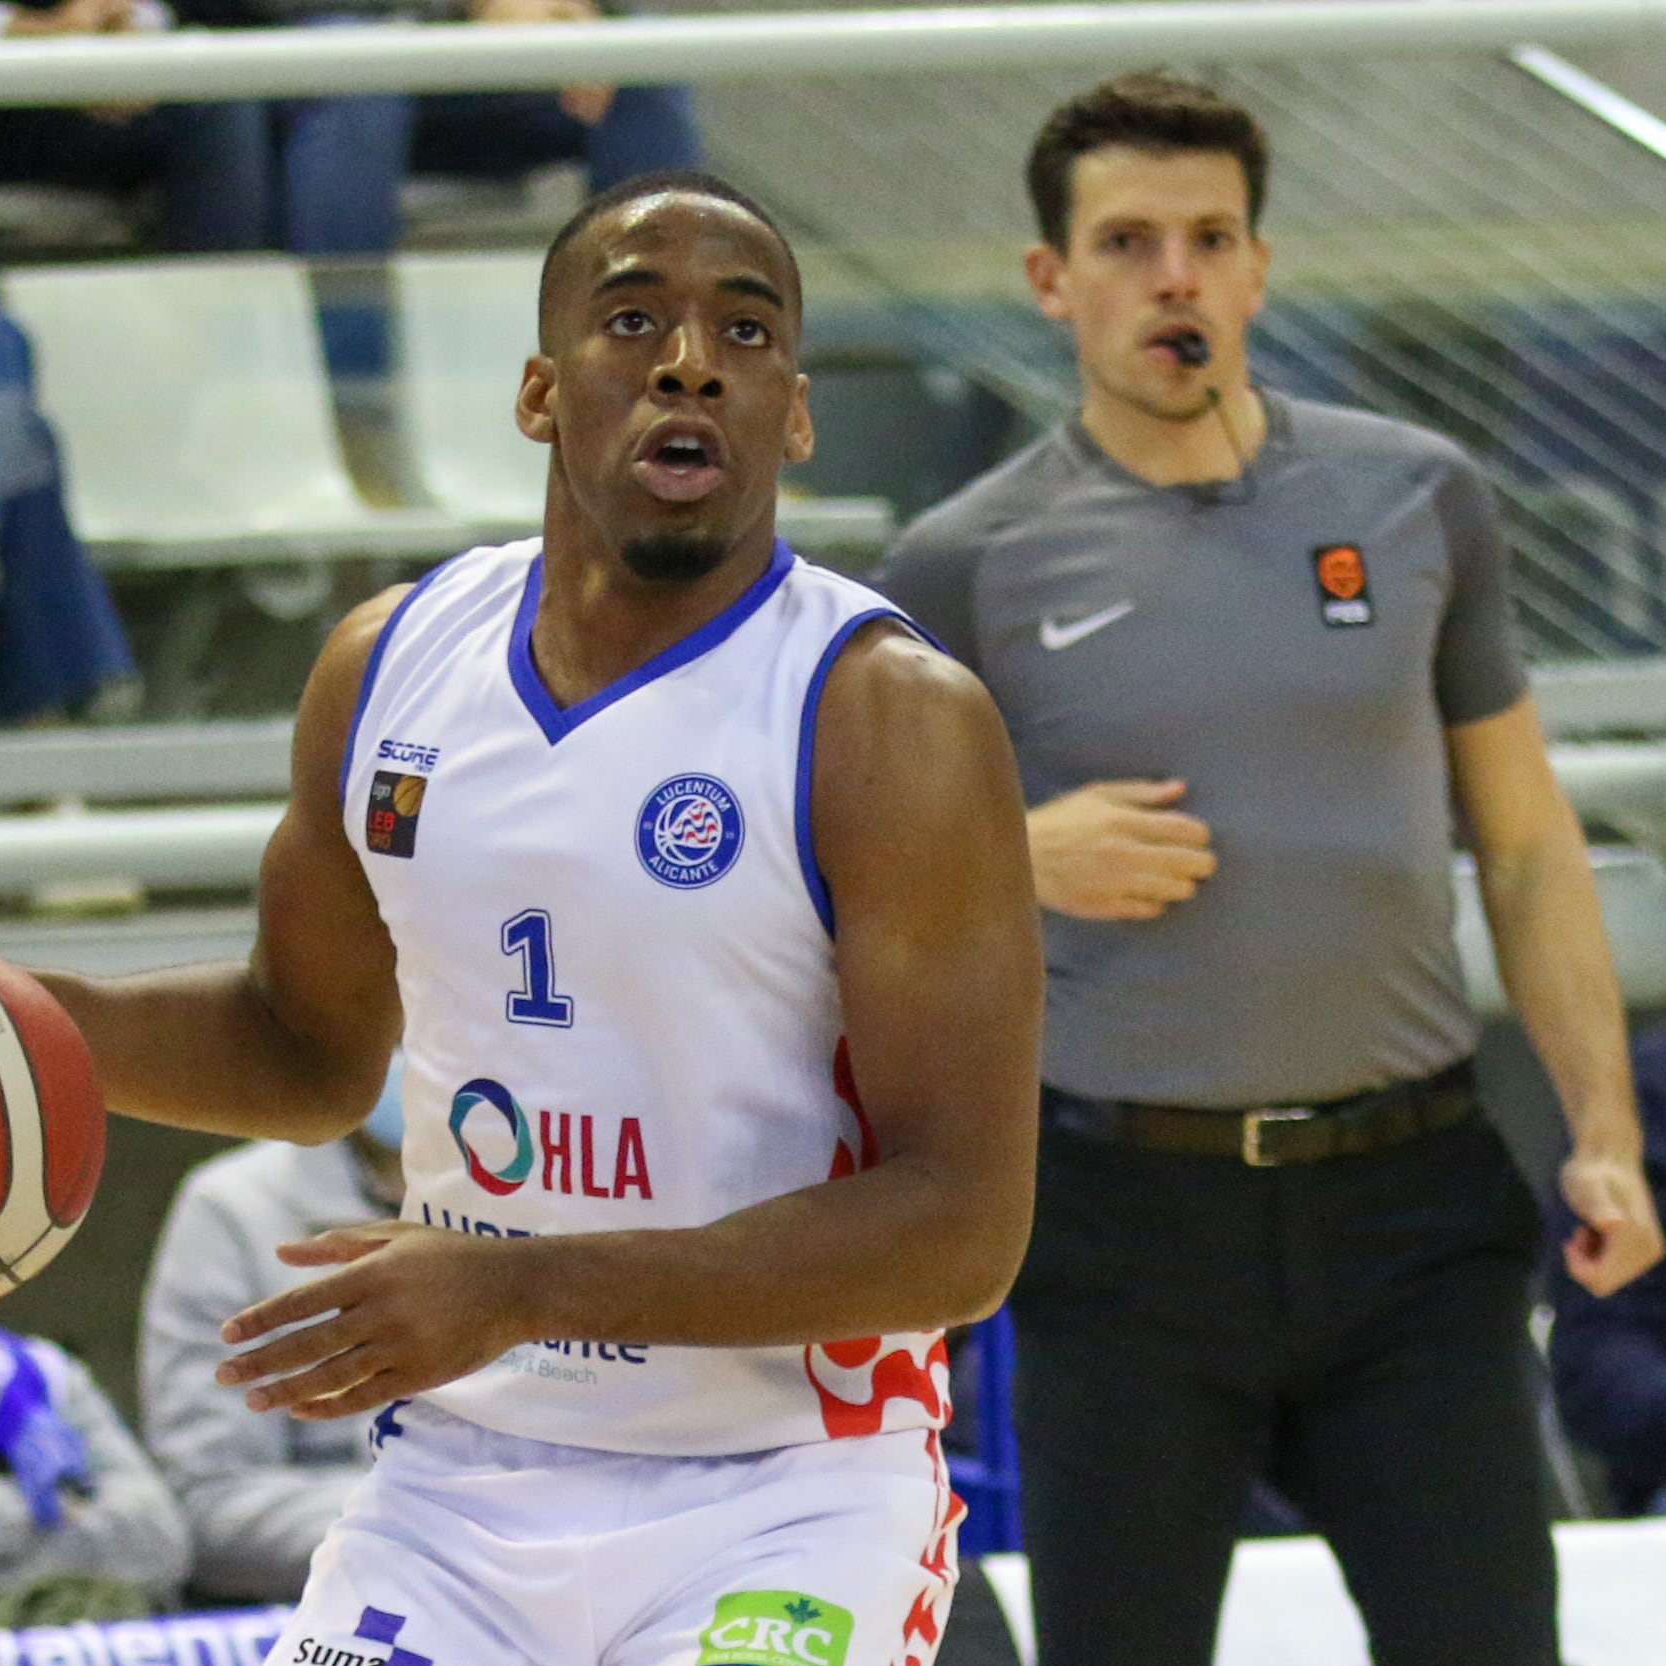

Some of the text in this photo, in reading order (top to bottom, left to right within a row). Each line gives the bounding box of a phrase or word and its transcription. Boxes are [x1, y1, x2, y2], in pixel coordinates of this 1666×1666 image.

[655, 780, 732, 812] LUCENTUM
[648, 855, 719, 882] ALICANTE
[500, 908, 574, 1028] 1
